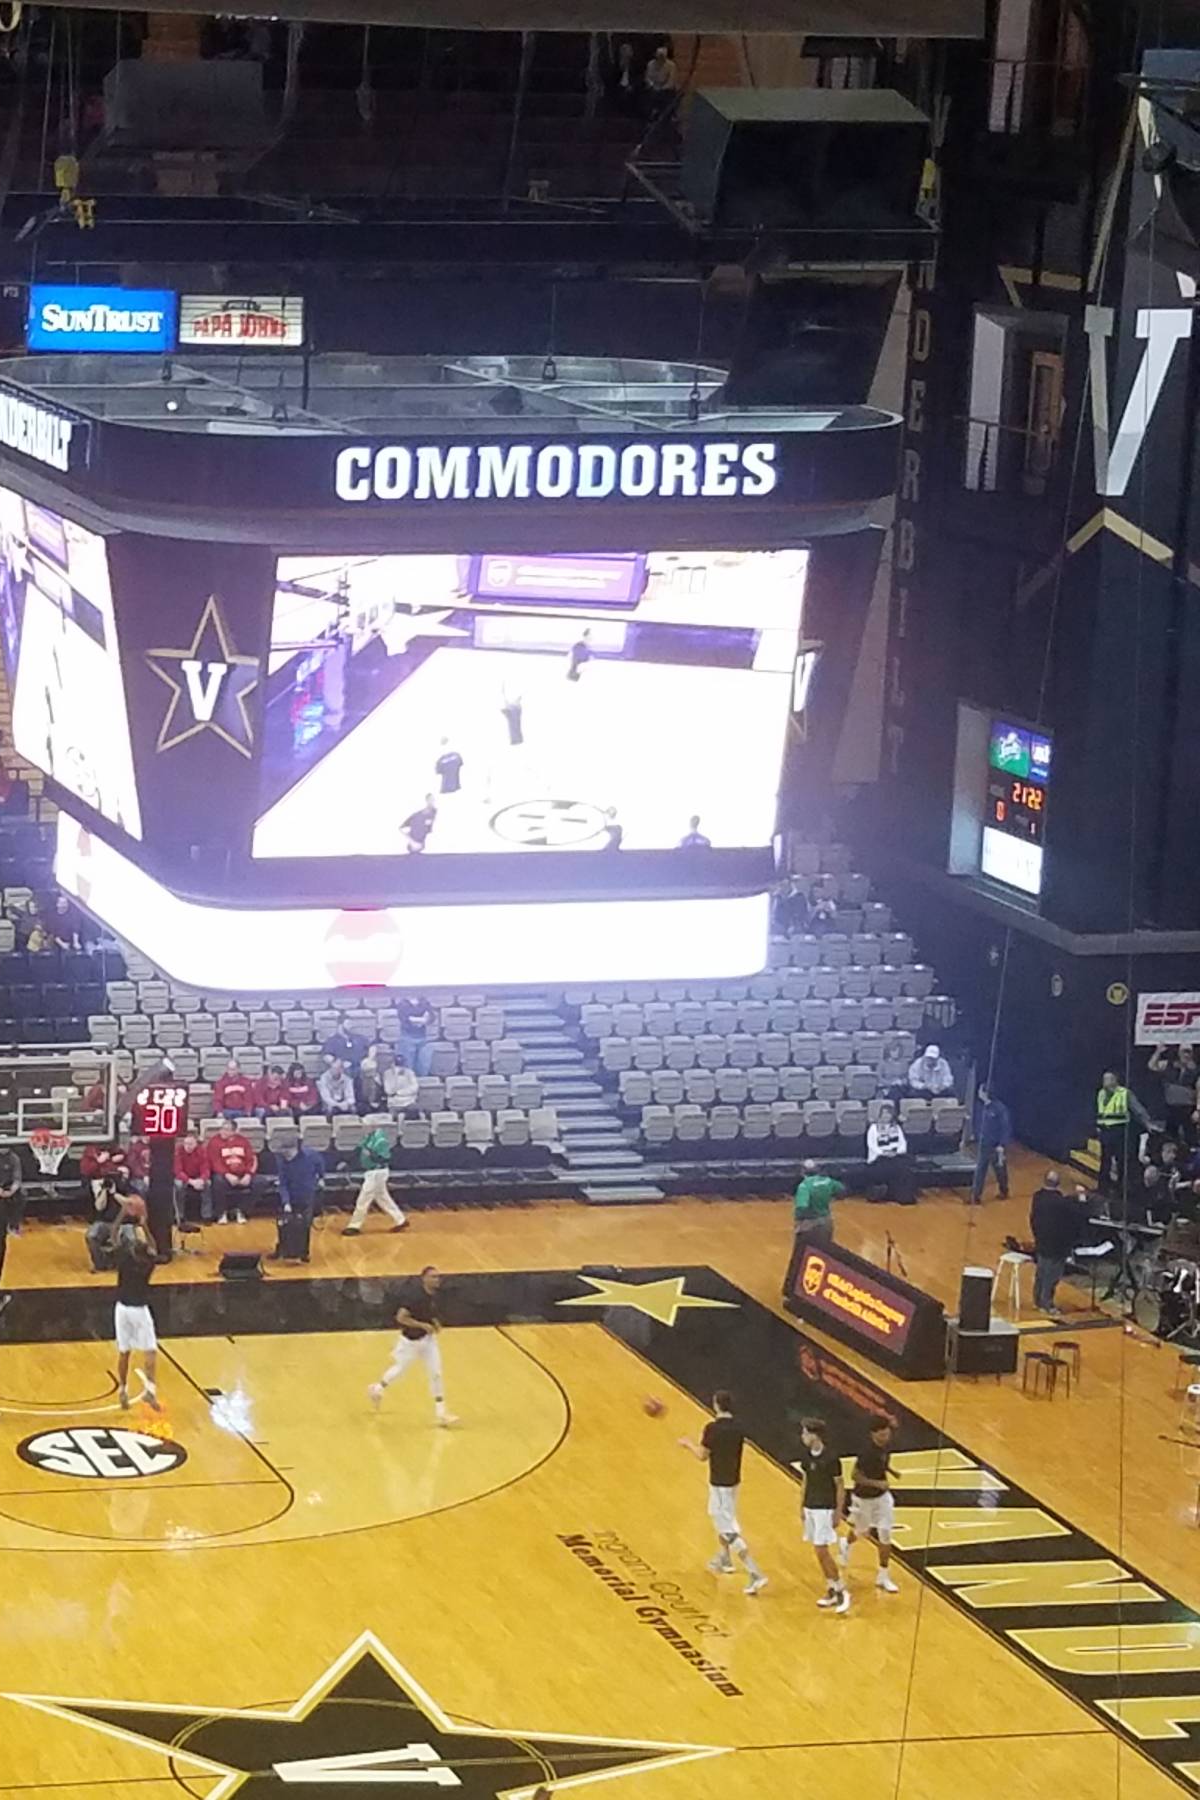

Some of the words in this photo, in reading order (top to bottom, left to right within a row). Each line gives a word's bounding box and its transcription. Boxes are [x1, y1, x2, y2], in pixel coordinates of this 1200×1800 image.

[192, 313, 232, 337] PAPA
[1084, 304, 1193, 497] V
[335, 442, 778, 501] COMMODORES
[181, 659, 228, 722] V
[144, 1104, 178, 1133] 30
[27, 1428, 178, 1477] SEC
[555, 1533, 651, 1602] Memorial
[636, 1605, 745, 1698] Gymnasium
